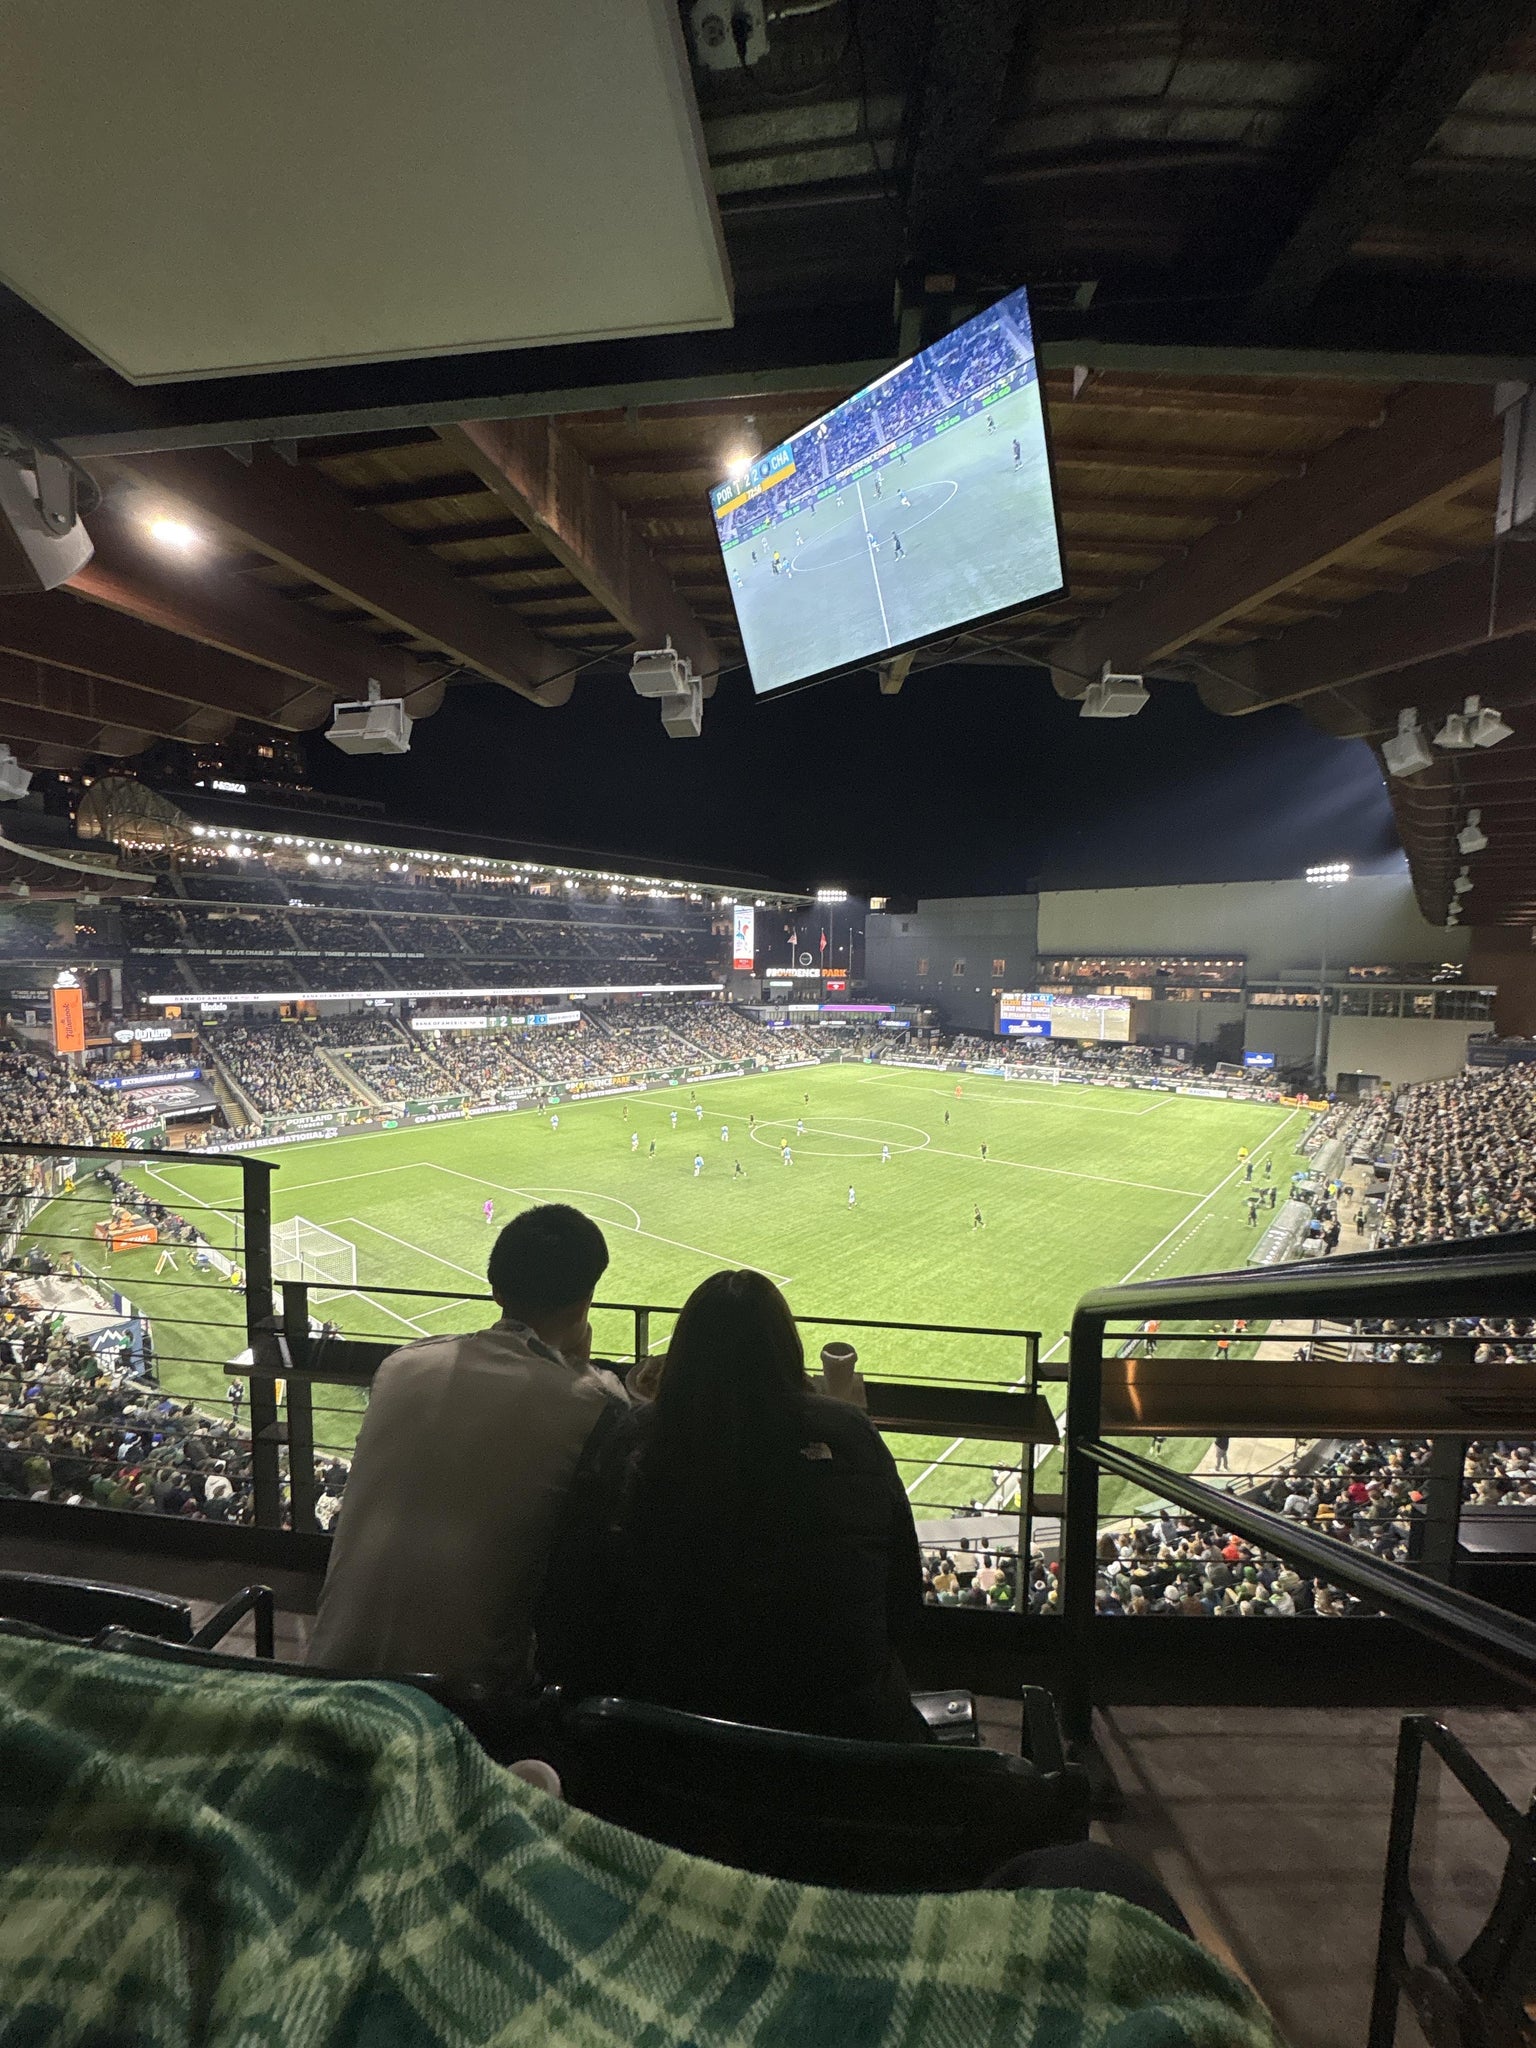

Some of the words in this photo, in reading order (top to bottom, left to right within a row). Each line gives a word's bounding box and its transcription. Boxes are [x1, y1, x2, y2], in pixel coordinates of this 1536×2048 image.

[716, 486, 733, 505] POR
[744, 474, 751, 487] 2
[751, 471, 759, 482] 2
[771, 450, 790, 470] CHA
[213, 780, 246, 793] HOKA
[766, 968, 820, 978] PROVIDENCE
[822, 968, 847, 978] PARK
[63, 1003, 74, 1039] Tillamook
[500, 1016, 508, 1027] 2
[528, 1014, 535, 1024] 2
[286, 1114, 333, 1126] PORTLAND
[221, 1140, 256, 1152] YOUTH
[256, 1131, 324, 1147] RECREATIONAL
